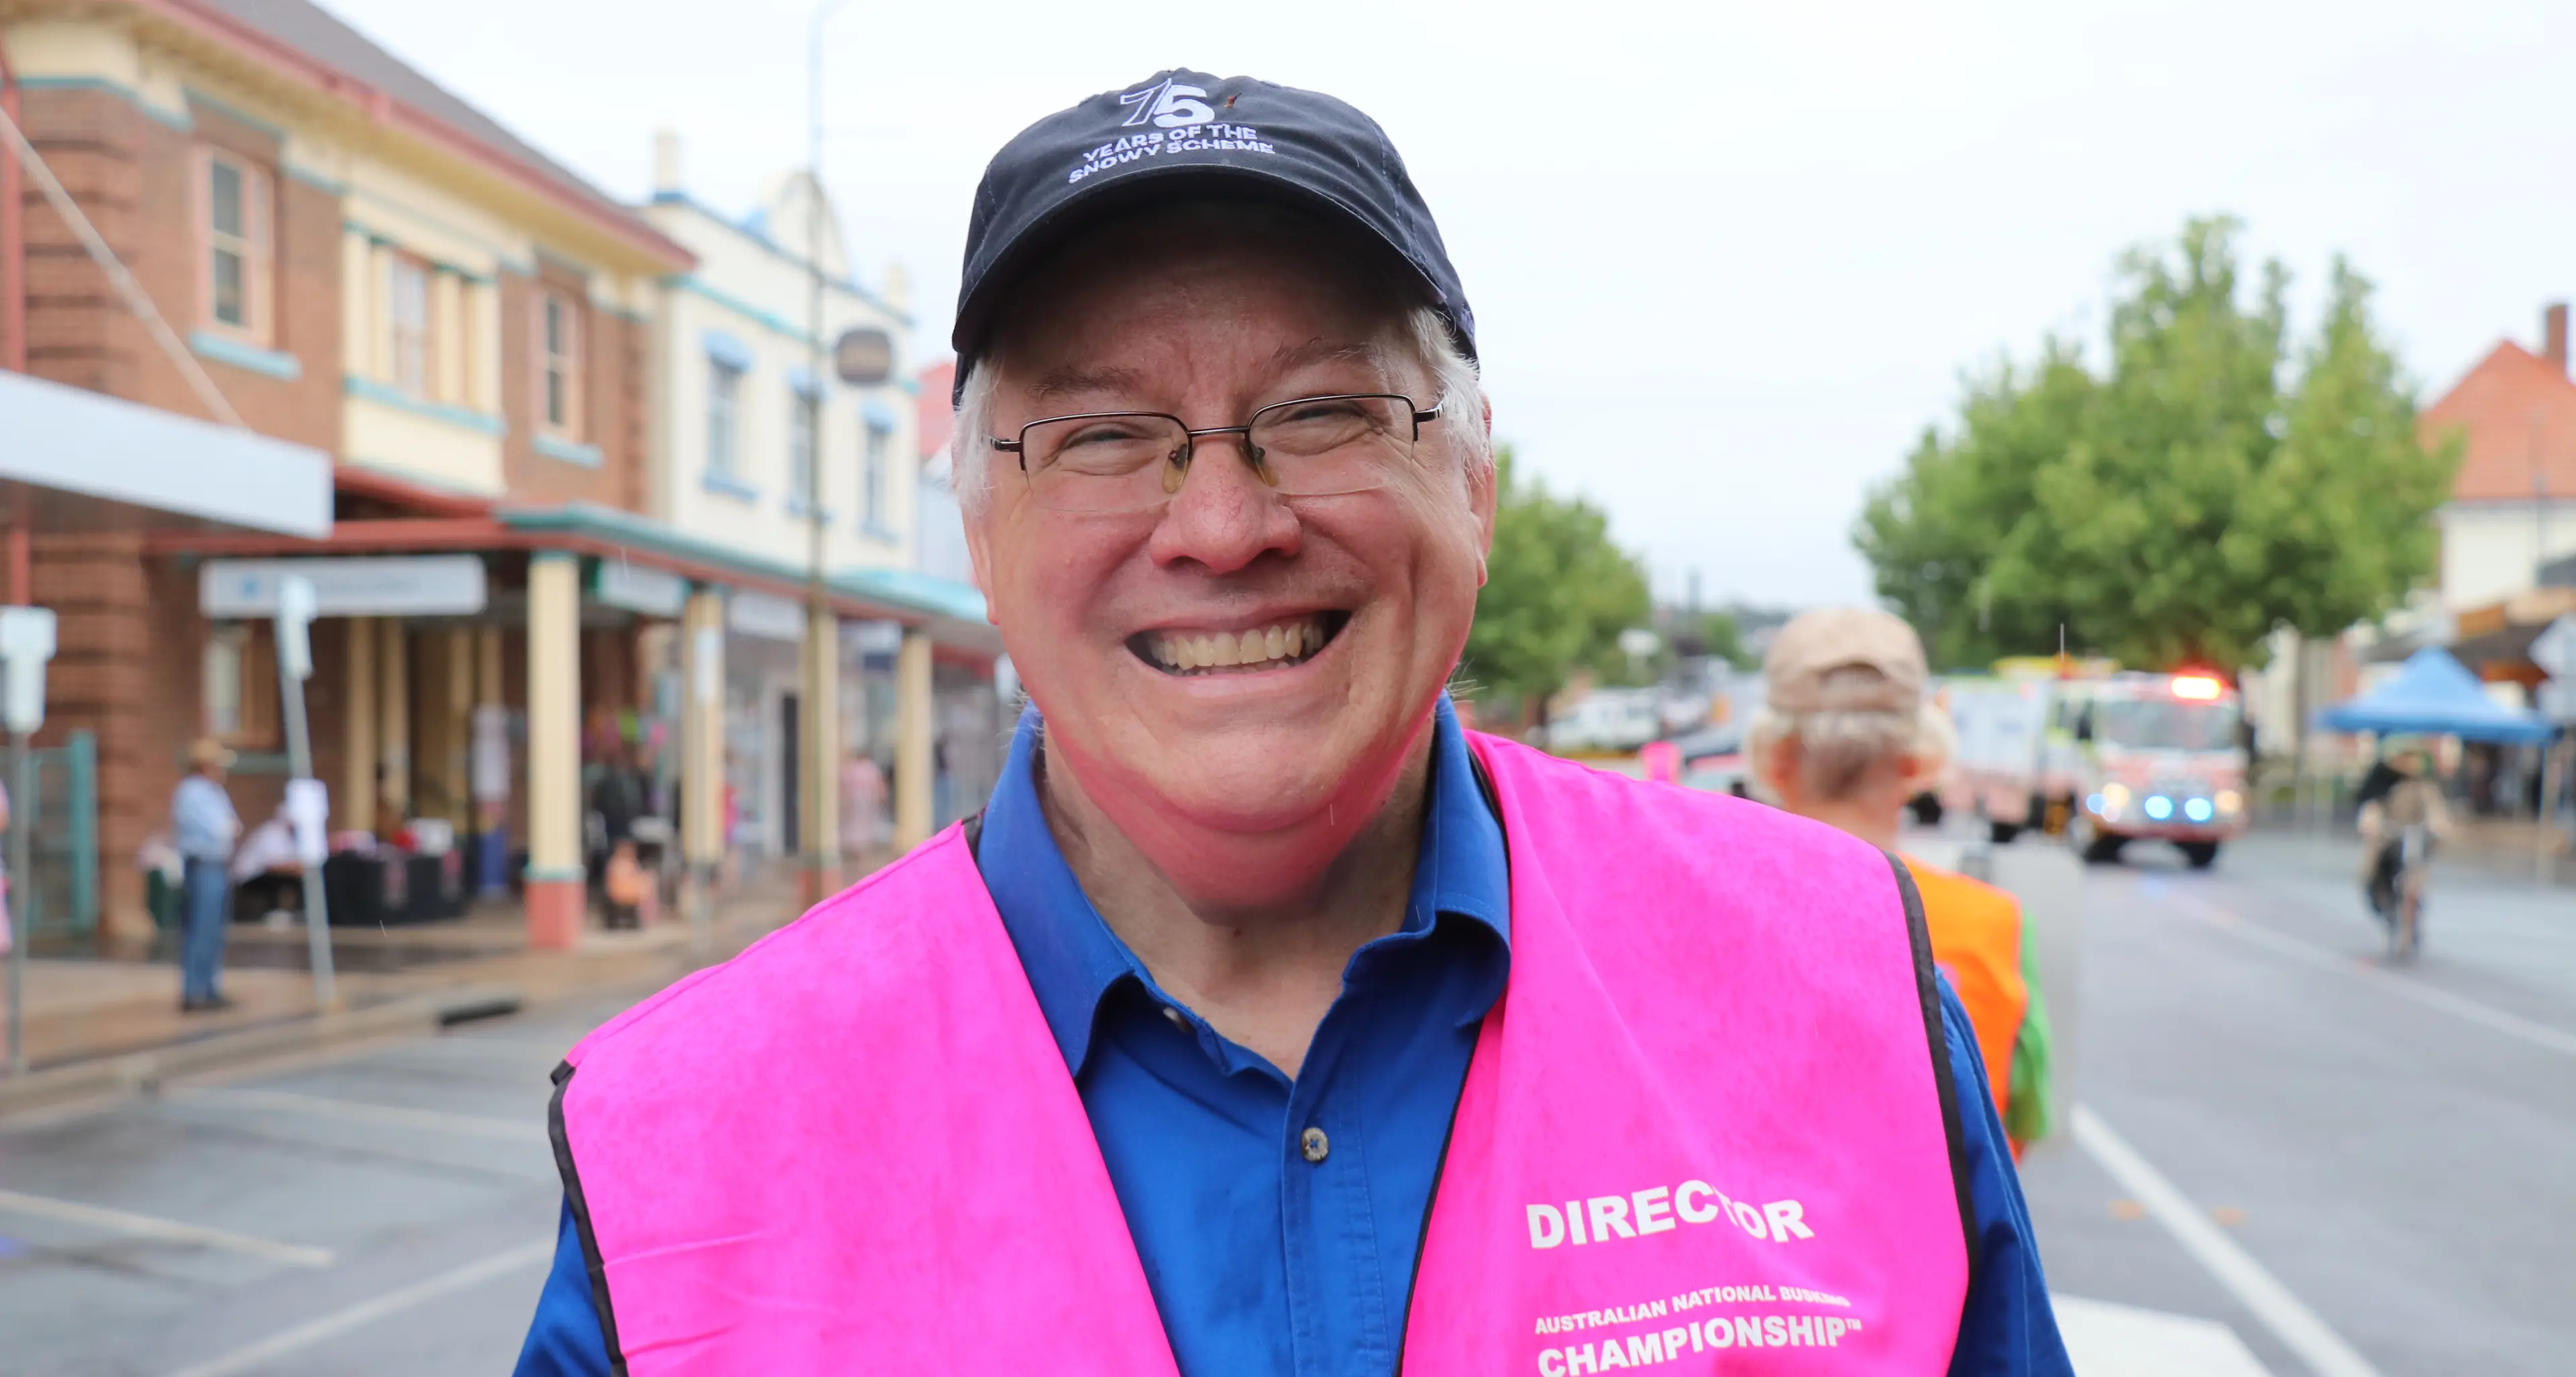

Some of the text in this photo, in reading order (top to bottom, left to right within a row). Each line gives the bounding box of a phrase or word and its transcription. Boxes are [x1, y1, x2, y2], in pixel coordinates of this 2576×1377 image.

[1120, 78, 1215, 128] 75
[1069, 139, 1276, 184] SNOWY SCHEME
[1083, 123, 1258, 162] YEARS OF THE
[1535, 1284, 1851, 1334] AUSTRALIAN NATIONAL BUSK
